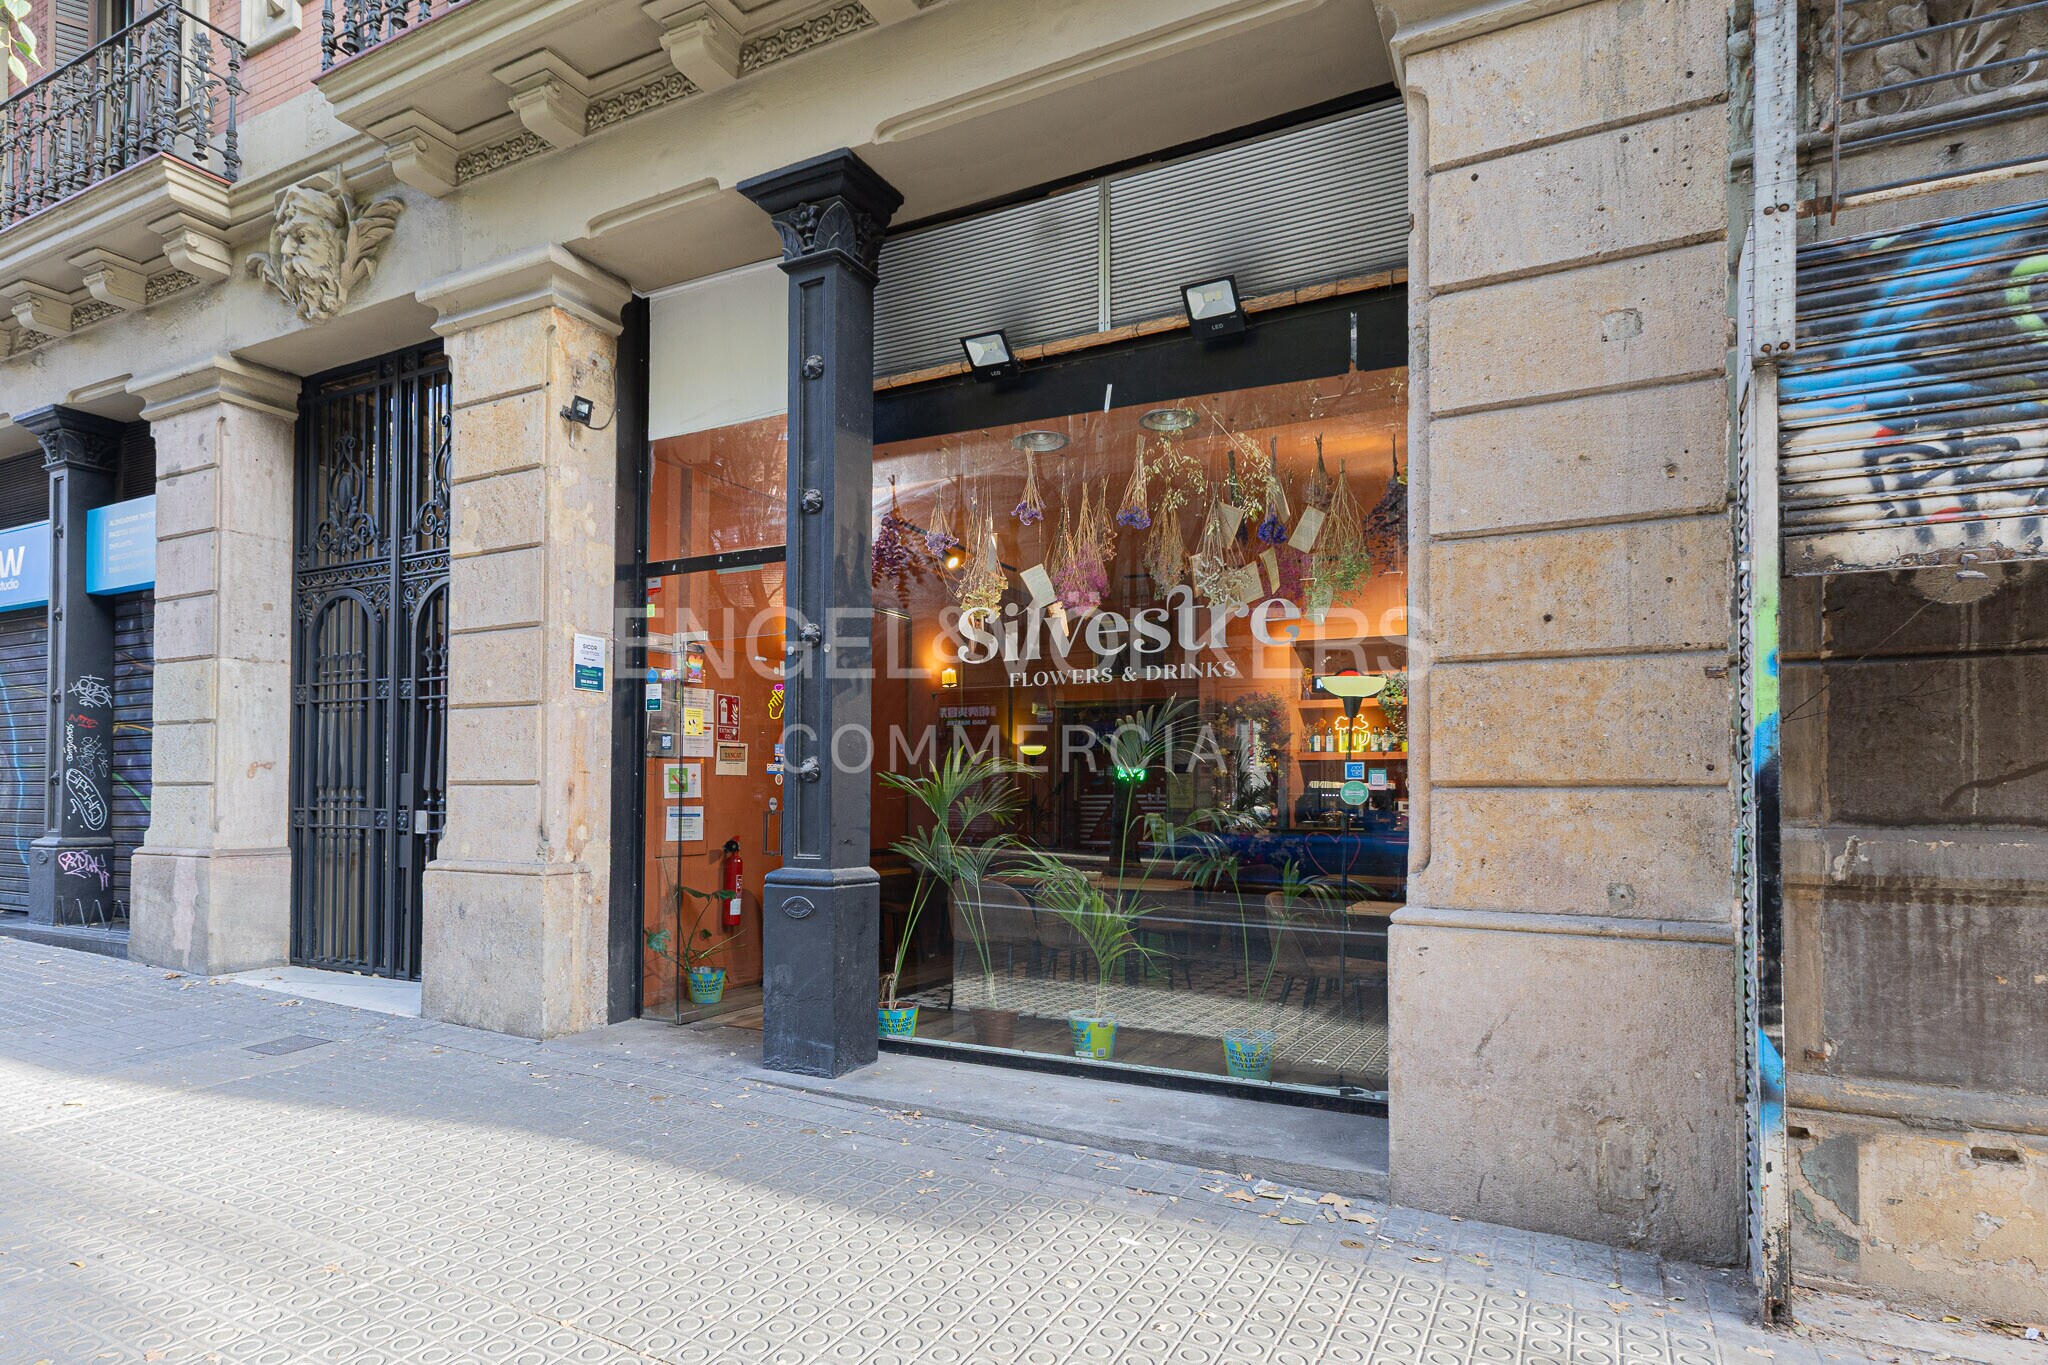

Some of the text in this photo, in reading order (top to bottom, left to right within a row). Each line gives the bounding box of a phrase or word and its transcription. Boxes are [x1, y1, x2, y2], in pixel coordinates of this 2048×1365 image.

[0, 578, 19, 592] tudio
[957, 584, 1300, 665] Silvestre
[1009, 660, 1237, 688] FLOWERS & DRINKS
